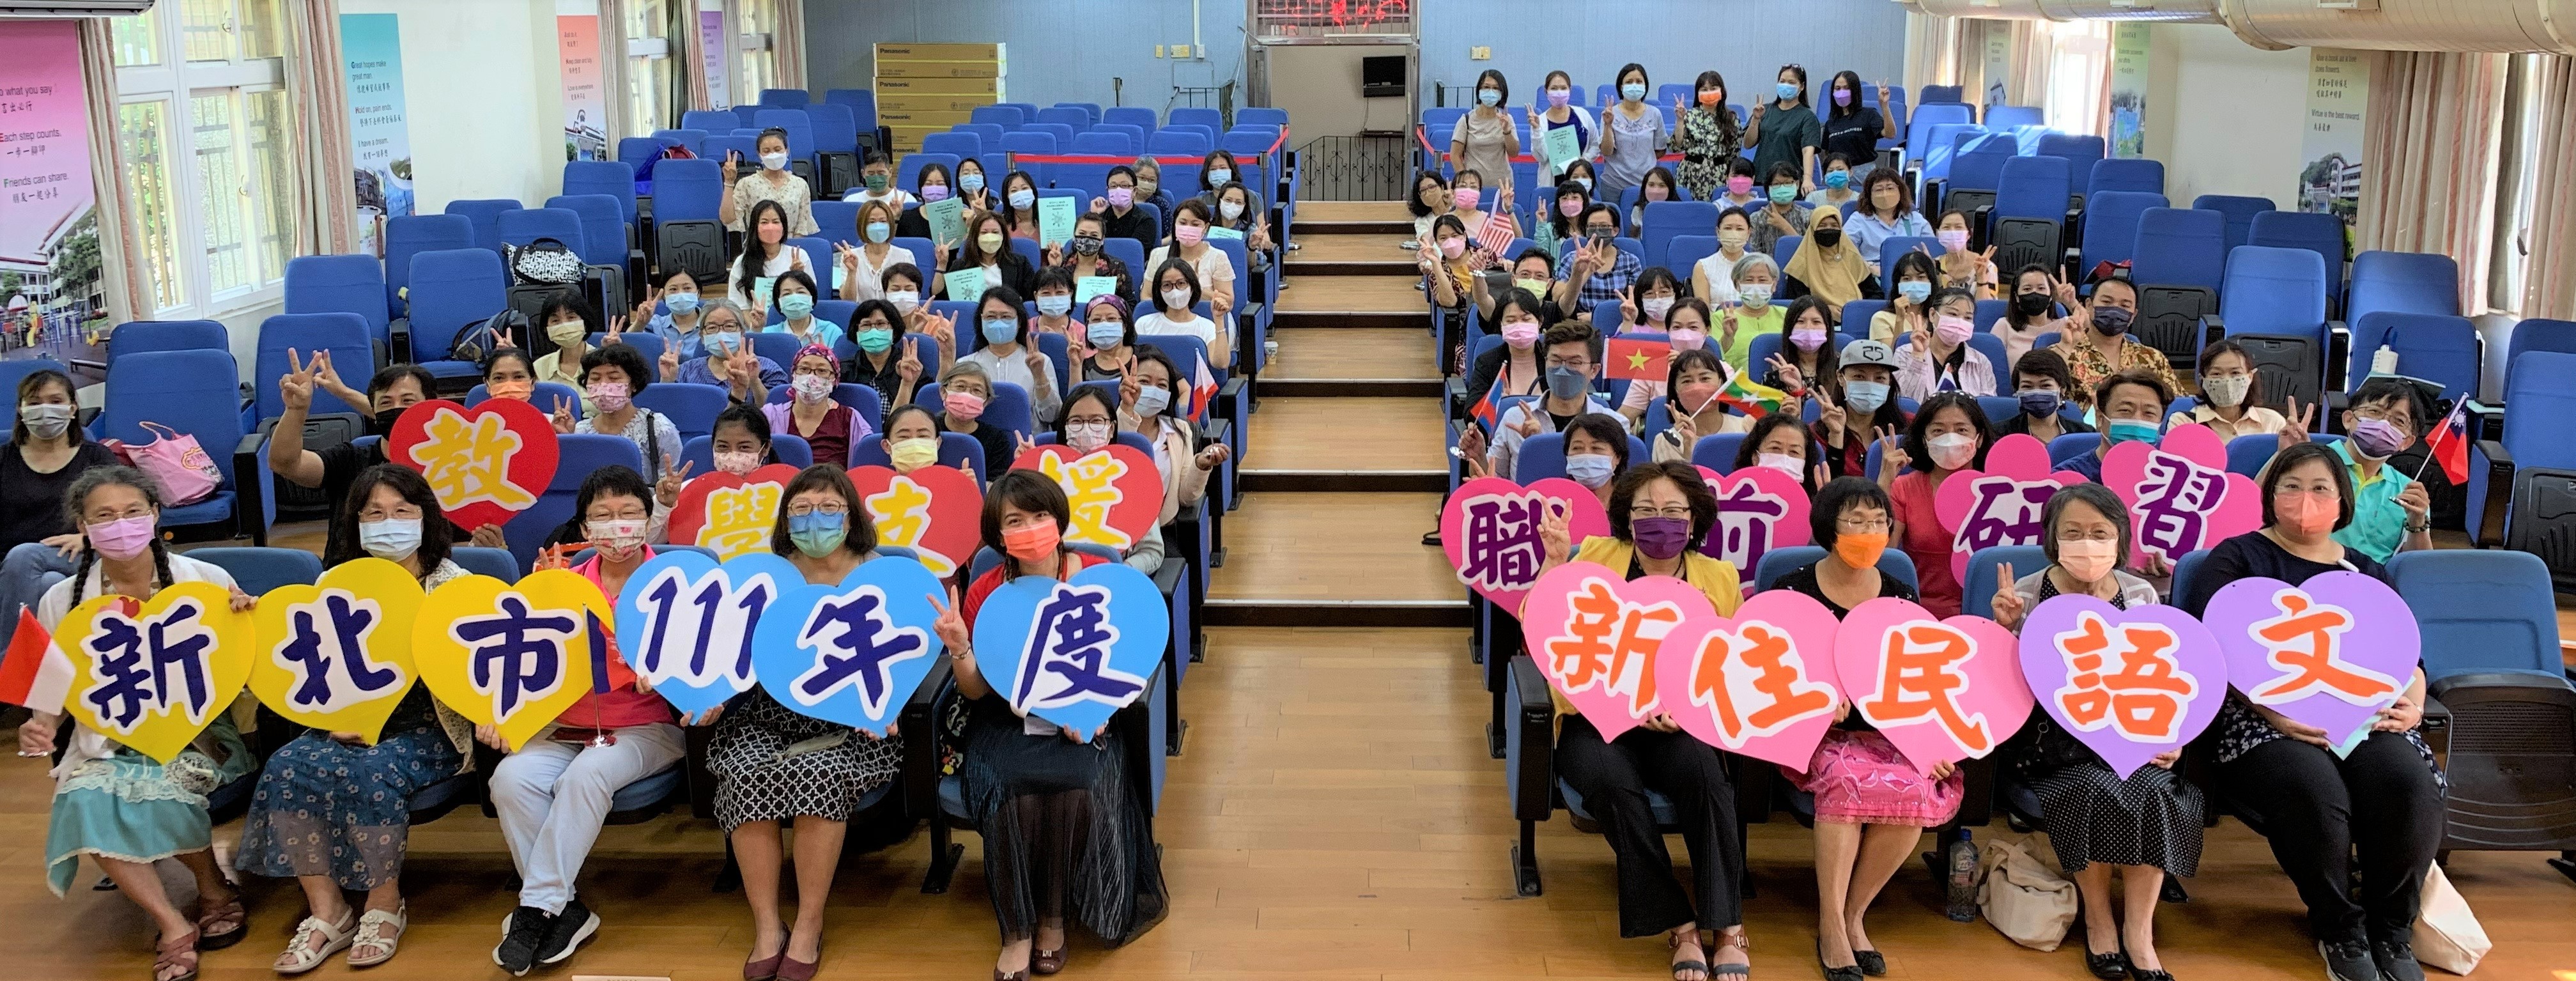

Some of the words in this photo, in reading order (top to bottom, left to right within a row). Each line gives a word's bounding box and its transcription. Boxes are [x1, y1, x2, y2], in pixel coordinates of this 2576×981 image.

[0, 132, 17, 143] Each
[19, 132, 35, 141] step
[36, 128, 62, 139] counts.
[5, 86, 24, 96] what
[25, 87, 38, 97] you
[3, 176, 31, 188] Friends
[33, 176, 47, 184] can
[412, 413, 536, 506] 教
[2139, 456, 2225, 561] 習
[89, 604, 210, 727] 新
[282, 595, 396, 705] 北
[456, 597, 575, 716] 市
[645, 576, 767, 680] 111
[802, 595, 921, 708] 年
[1017, 590, 1143, 708] 度
[1551, 583, 1677, 711] 新
[1695, 626, 1830, 738] 住
[1866, 626, 1987, 750] 民
[2063, 618, 2191, 736] 語
[2260, 595, 2394, 697] 文
